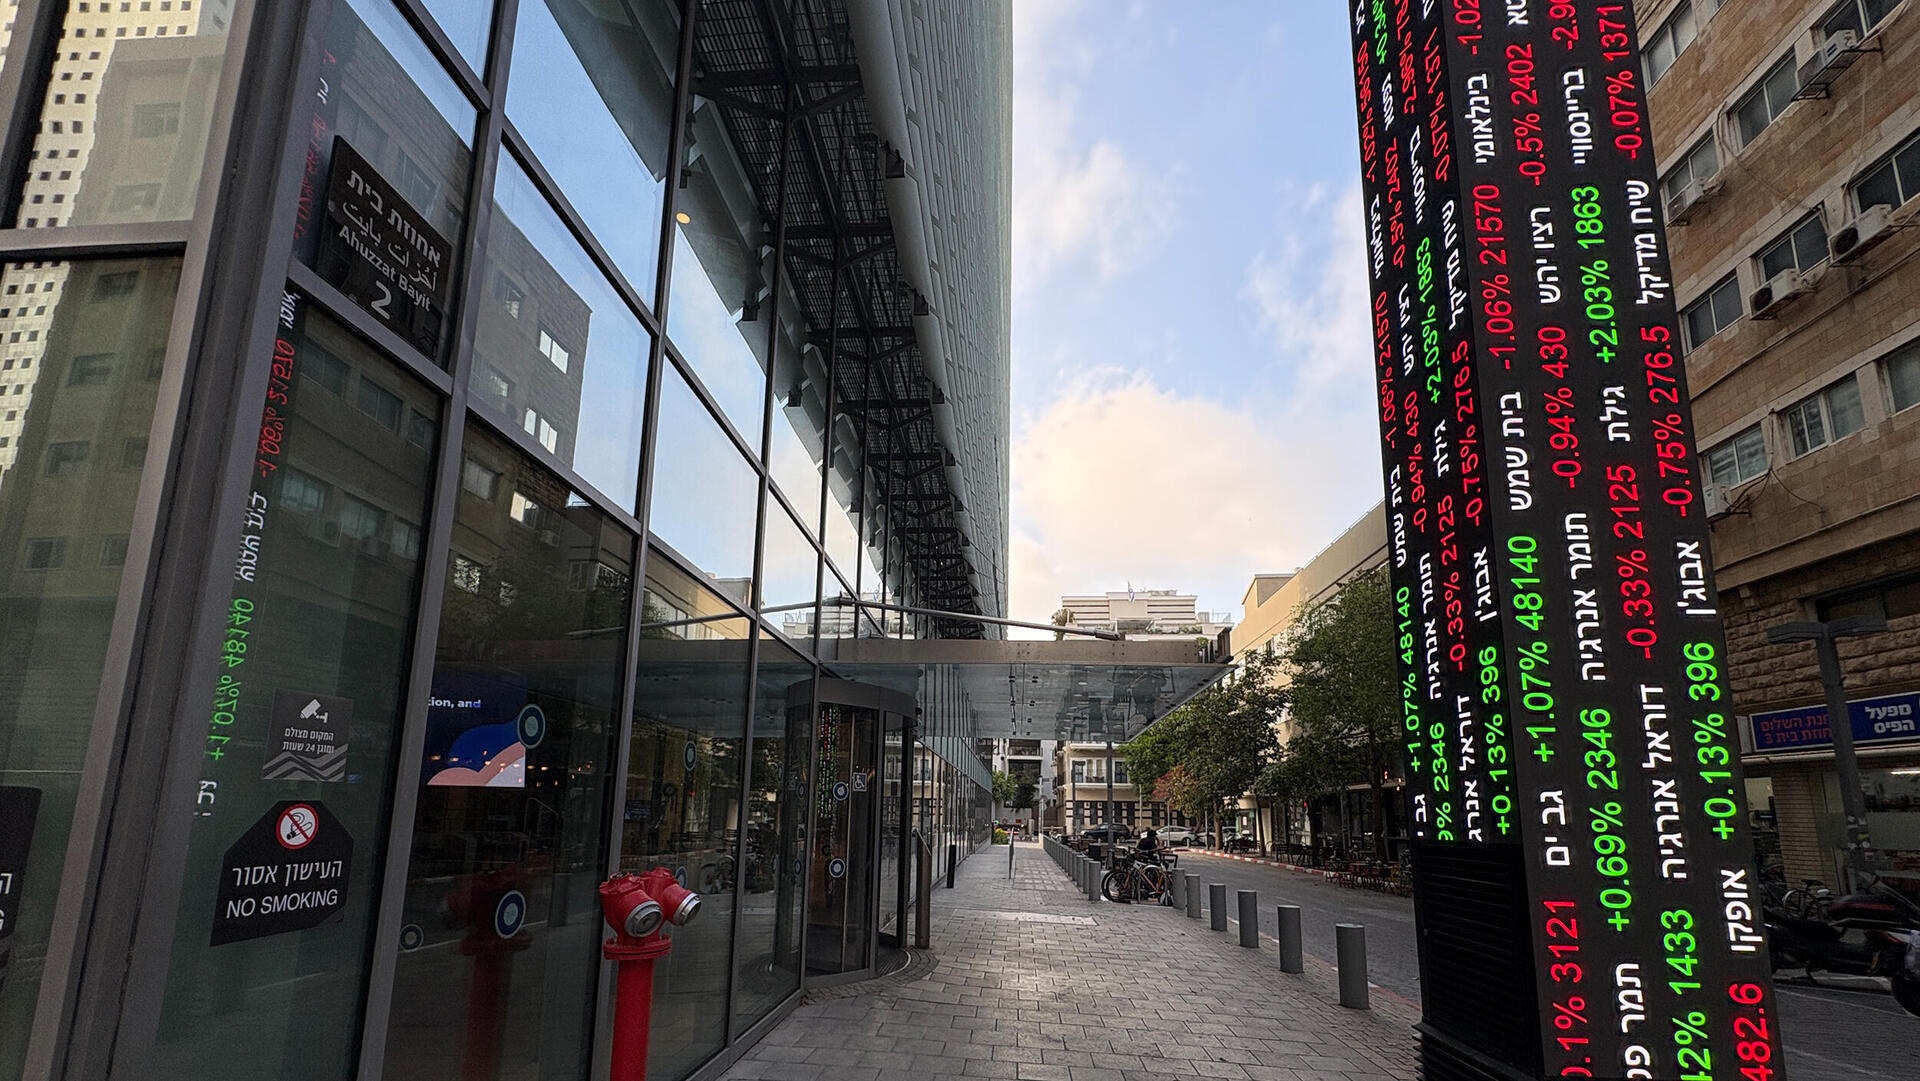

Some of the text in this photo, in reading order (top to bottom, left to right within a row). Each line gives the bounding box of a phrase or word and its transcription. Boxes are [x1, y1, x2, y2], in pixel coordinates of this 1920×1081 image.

[1423, 27, 1442, 95] 1371
[1548, 0, 1579, 51] -2.9
[1464, 73, 1496, 164] בינלאומי
[1505, 43, 1547, 186] -0.5% 2402
[1596, 5, 1643, 160] -0.07% 1371
[347, 170, 383, 215] בית
[388, 208, 440, 268] אחוזת
[1384, 137, 1406, 269] -0.5% 2402
[339, 225, 431, 312] Ahuzzat Bayit
[1441, 199, 1467, 331] שיח מדיקל
[1472, 184, 1517, 370] -1.06% 21570
[1530, 207, 1561, 304] רציו יהש
[1571, 186, 1619, 364] +2.03% 1863
[1626, 180, 1670, 305] שיח מדיקל
[371, 280, 392, 320] 2
[1415, 236, 1442, 404] +2.03% 1863
[1375, 291, 1397, 449] -1.06% 21570
[1537, 326, 1582, 489] -0.94% 430
[1599, 385, 1631, 442] גילת
[1403, 390, 1427, 533] -0.94% 430
[1432, 419, 1450, 478] גילת
[1451, 340, 1483, 527] -0.75% 276.5
[1500, 391, 1533, 511] בית שמש
[1640, 325, 1693, 517] -0.75% 276.5
[1390, 464, 1407, 568] בית שמש
[1606, 464, 1658, 659] -0.33% 2125
[1437, 495, 1466, 672] -0.33% 2125
[1564, 513, 1606, 681] תומר אנרגיה
[1676, 541, 1717, 615] אבוג'ן
[1419, 552, 1442, 700] תומר אנרגיה
[1507, 535, 1557, 763] +1.07% 48140
[457, 699, 482, 708] and
[1396, 586, 1422, 773] +1.07% 48140
[1865, 703, 1913, 719] מפעל
[282, 741, 304, 751] שעות
[284, 726, 334, 741] המקום מצולם
[305, 743, 315, 752] 24
[1429, 722, 1450, 792] 2346
[1457, 695, 1476, 771] דוראל
[1479, 646, 1512, 835] +0.13% 396
[1683, 642, 1737, 840] +0.13% 396
[1765, 733, 1774, 745] 3
[1874, 719, 1916, 734] הפיס
[1414, 793, 1427, 823] גב
[1579, 708, 1632, 932] +0.69% 2346
[1640, 684, 1687, 879] דוראל אנרגיה
[232, 860, 343, 887] העישון אסור
[1539, 790, 1571, 866] גב ים
[226, 889, 338, 919] NO SMOKING
[1543, 900, 1583, 984] 3121
[1720, 869, 1763, 952] אופקו
[1660, 909, 1701, 995] 1433
[1615, 963, 1646, 1033] תמר
